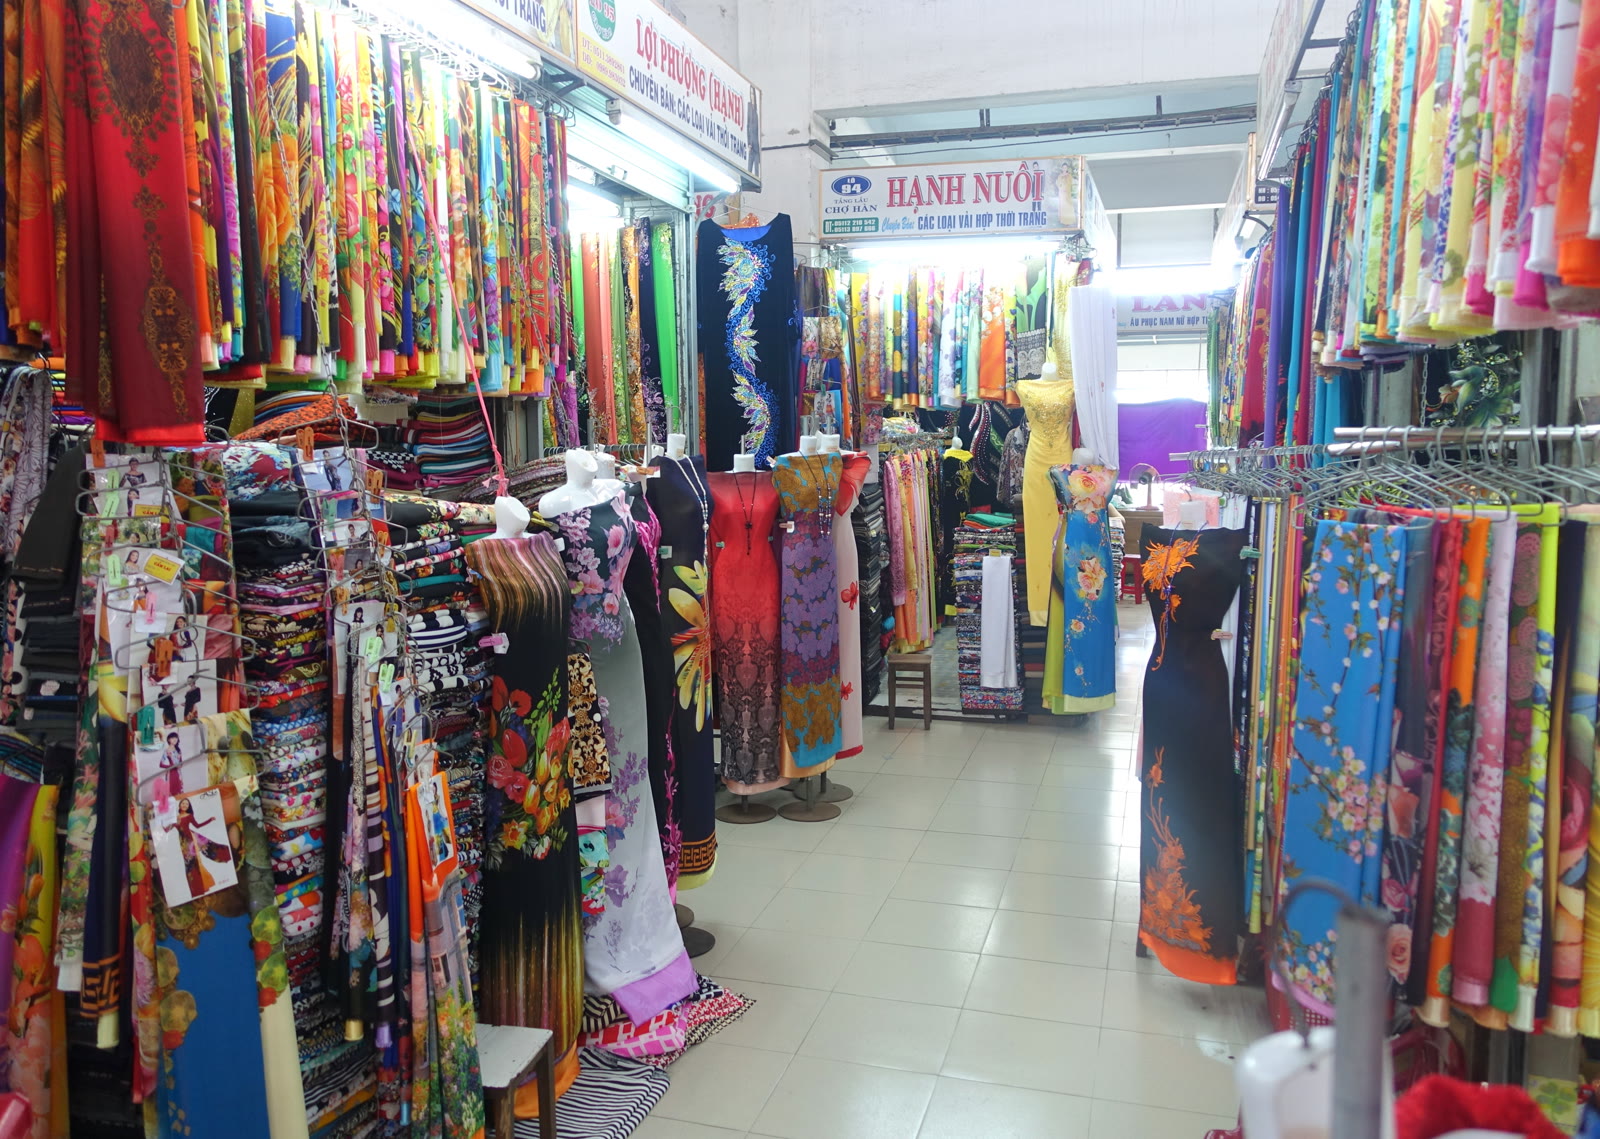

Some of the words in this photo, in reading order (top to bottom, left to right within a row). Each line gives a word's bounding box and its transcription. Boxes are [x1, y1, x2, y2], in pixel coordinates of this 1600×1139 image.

[636, 18, 657, 70] LỢI
[660, 38, 706, 101] PHƯỢNG
[709, 72, 744, 131] (HẠNH)
[629, 65, 659, 104] CHUYÊN
[677, 96, 690, 124] CÁC
[691, 107, 704, 138] LOẠI
[705, 113, 716, 141] VẢI
[730, 134, 747, 160] TRANG
[841, 184, 861, 194] 94
[886, 175, 965, 214] HẠNH
[973, 163, 1044, 204] NUÔI
[825, 204, 849, 214] CHỢ
[853, 203, 877, 213] HÀN
[917, 213, 935, 230] CÁC
[937, 214, 957, 232] LOẠI
[959, 211, 973, 229] VẢI
[975, 212, 993, 231] HỢP
[996, 210, 1016, 227] THỜI
[1018, 211, 1047, 226] TRANG
[1132, 294, 1207, 312] LAN
[1141, 316, 1158, 327] PHỤC
[1160, 316, 1175, 326] NAM
[1187, 315, 1200, 327] HỢP
